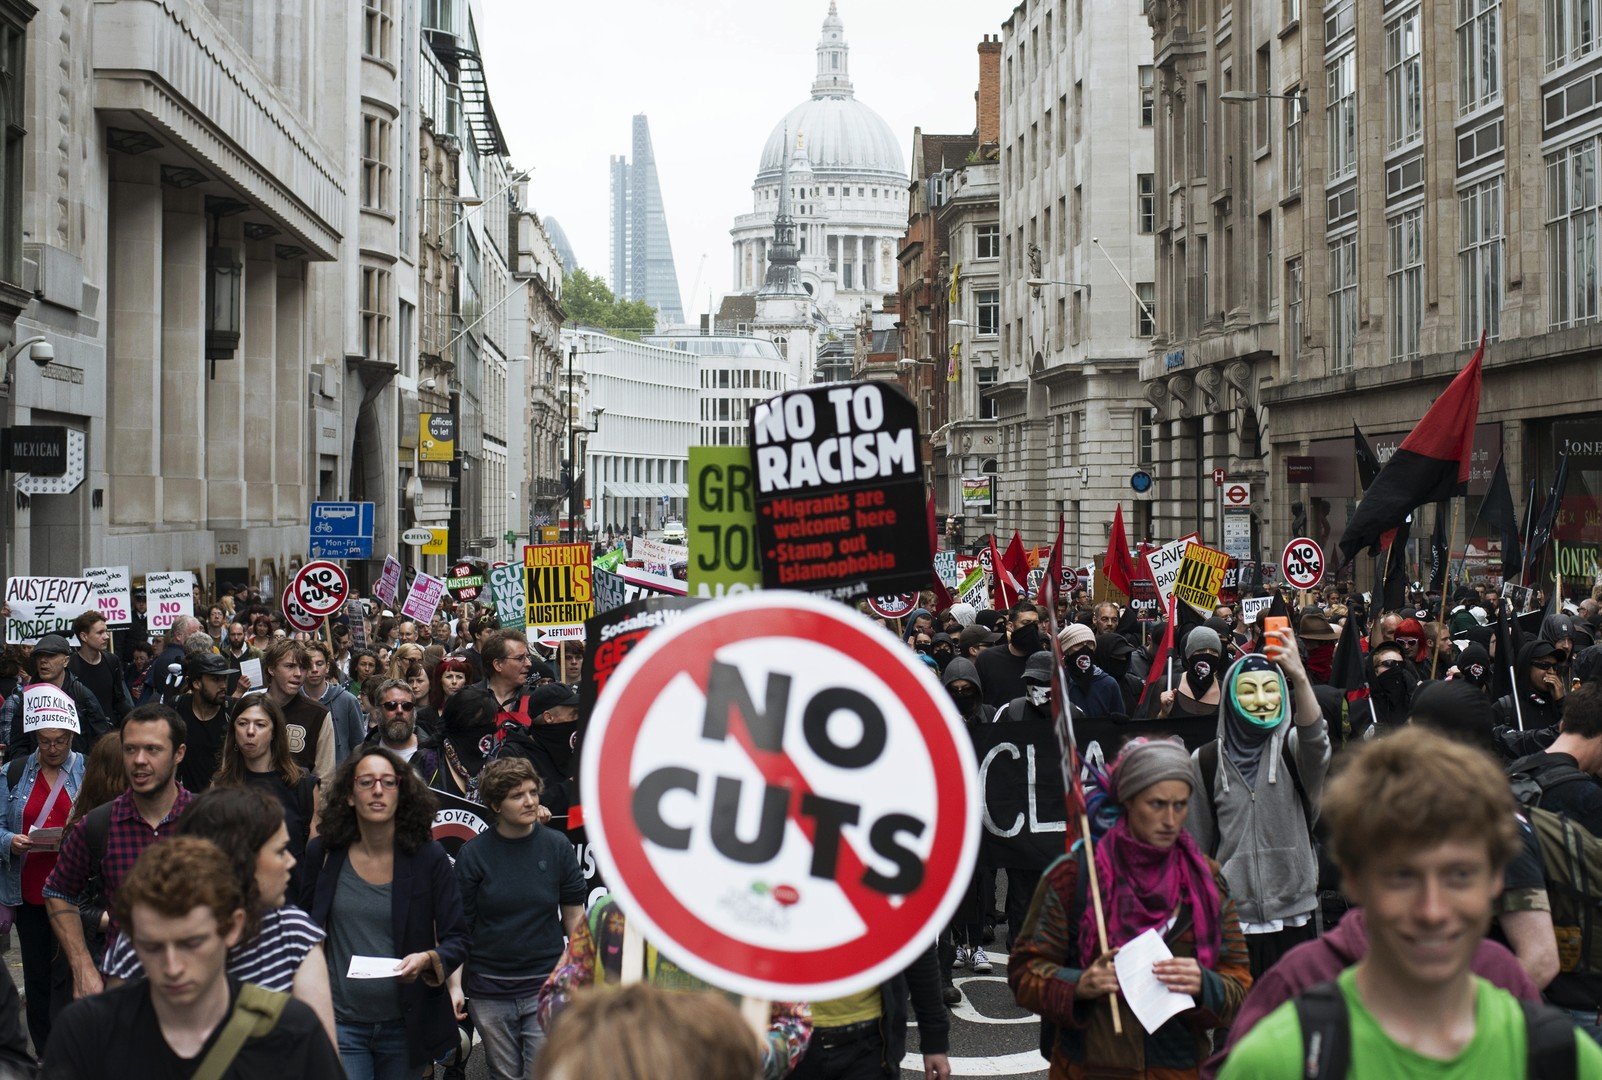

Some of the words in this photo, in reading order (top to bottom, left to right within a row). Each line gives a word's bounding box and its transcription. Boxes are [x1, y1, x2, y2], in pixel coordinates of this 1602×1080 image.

[431, 417, 453, 426] offices
[754, 396, 816, 446] NO
[828, 384, 884, 435] TO
[431, 428, 438, 436] to
[440, 427, 449, 436] let
[14, 442, 60, 457] MEXICAN
[1376, 441, 1398, 463] Sainsb
[1558, 439, 1602, 456] JONE
[757, 428, 916, 493] RACISM
[1214, 471, 1224, 482] H
[772, 493, 850, 519] Migrants
[854, 489, 885, 508] are
[773, 515, 851, 540] welcome
[855, 509, 897, 529] here
[219, 544, 239, 556] 135
[526, 545, 589, 567] AUSTERITY
[776, 540, 833, 563] Stamp
[839, 533, 867, 555] out
[1185, 543, 1230, 569] AUSTERITY
[1292, 547, 1314, 560] NO
[934, 551, 956, 563] CUT
[934, 560, 956, 571] WAR
[1151, 544, 1185, 570] SAVE
[1550, 539, 1598, 583] JONES
[456, 566, 470, 577] END
[490, 563, 525, 588] CU
[778, 551, 896, 584] Islamophobia
[1288, 561, 1320, 577] CUTS
[106, 573, 123, 582] jobs
[147, 573, 171, 583] defend
[168, 578, 185, 587] jobs
[303, 570, 332, 587] NO
[447, 576, 482, 590] AUSTERITY
[527, 564, 590, 604] KILLS
[594, 569, 623, 593] CUT
[1178, 557, 1224, 596] KILLS
[7, 579, 94, 606] AUSTERITY
[92, 581, 110, 590] efend
[97, 586, 128, 596] education
[149, 586, 172, 595] defend
[301, 582, 343, 604] CUTS
[460, 587, 477, 600] NOW
[493, 579, 525, 600] WA
[595, 583, 623, 605] WAR
[961, 589, 975, 604] KEEP
[974, 578, 986, 593] THE
[98, 597, 119, 609] NO
[159, 591, 191, 601] education
[1131, 599, 1157, 609] Out!
[1174, 584, 1218, 609] AUSTERITY
[160, 602, 180, 613] NO
[496, 594, 525, 616] NO
[528, 602, 591, 624] AUSTERITY
[1244, 599, 1260, 613] CUTS
[102, 609, 127, 622] UTS
[500, 610, 525, 623] WELF
[9, 618, 76, 642] PROSPERIT
[548, 627, 584, 637] LEFTUNITY
[33, 695, 52, 709] CUTS
[53, 696, 69, 712] KILL
[25, 714, 41, 727] Stop
[701, 659, 889, 770] NO
[285, 723, 307, 754] B
[632, 765, 928, 897] CUTS
